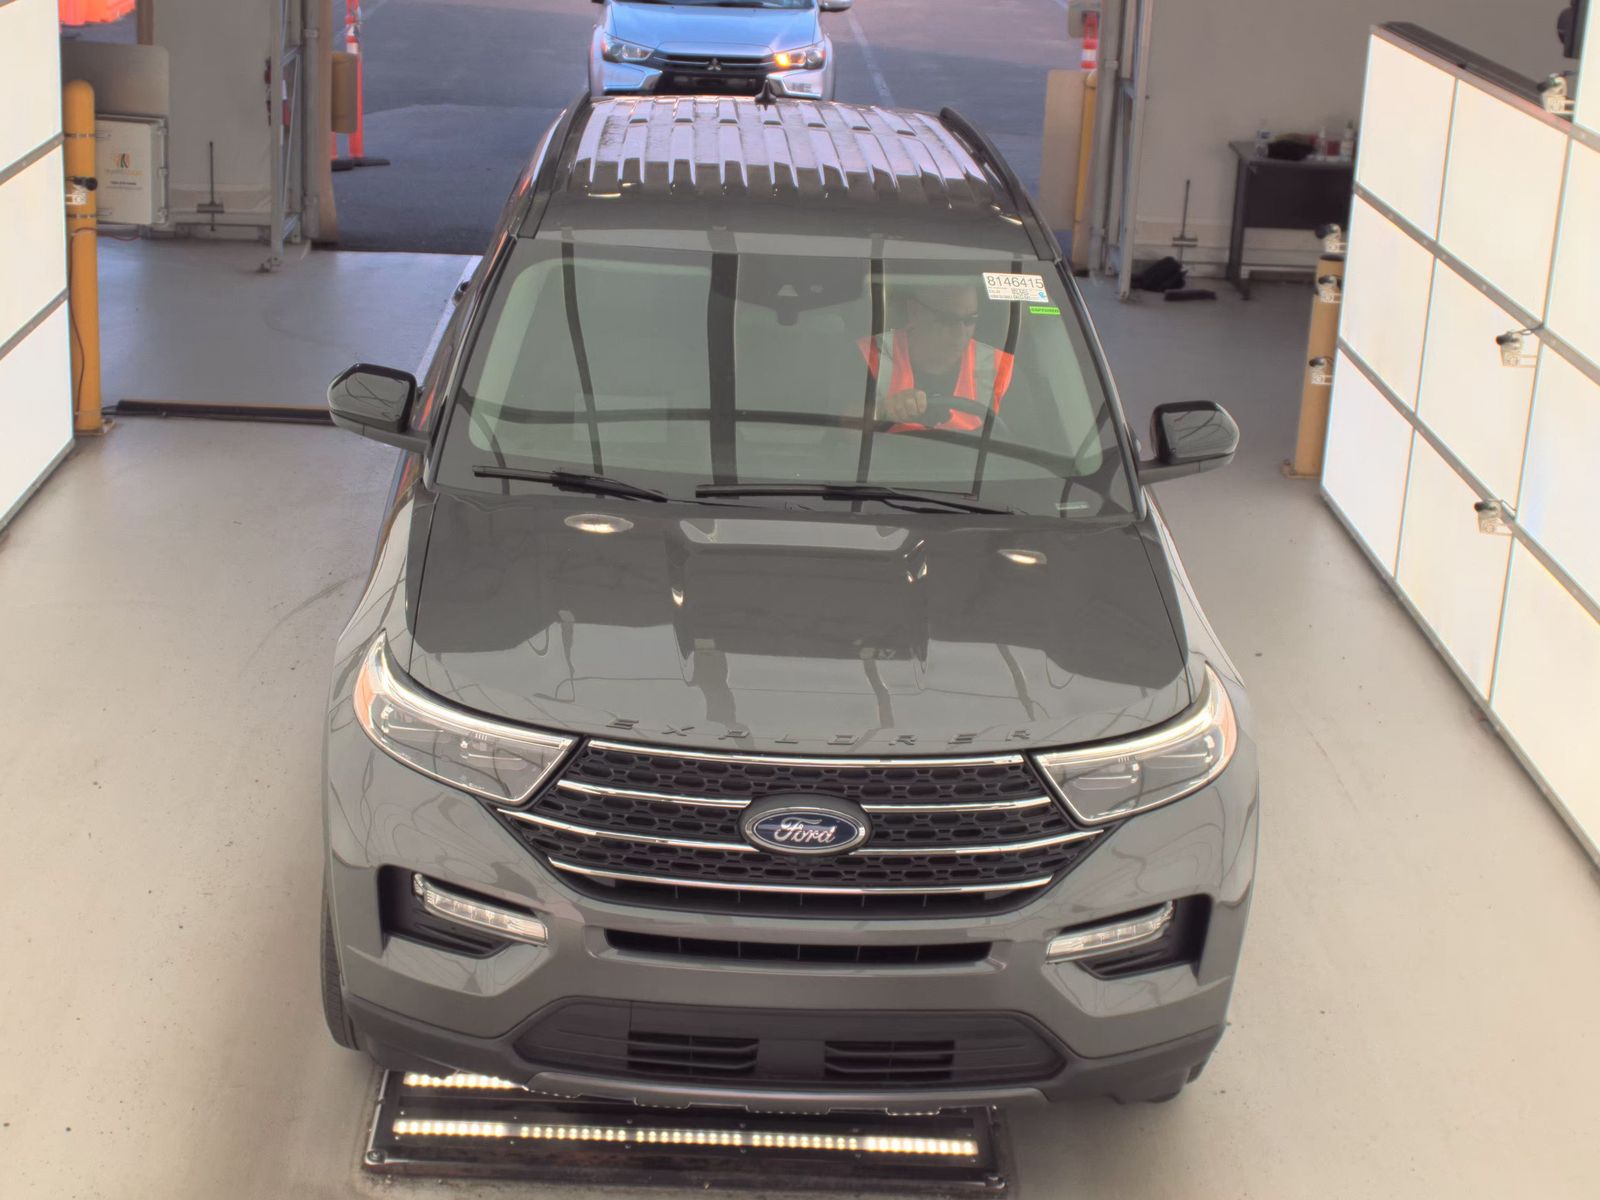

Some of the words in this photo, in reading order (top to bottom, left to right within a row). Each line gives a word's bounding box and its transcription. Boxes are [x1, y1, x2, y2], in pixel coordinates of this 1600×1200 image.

[986, 275, 1044, 289] 8146415
[606, 717, 1032, 746] EXPLORER
[773, 816, 838, 844] Ford
